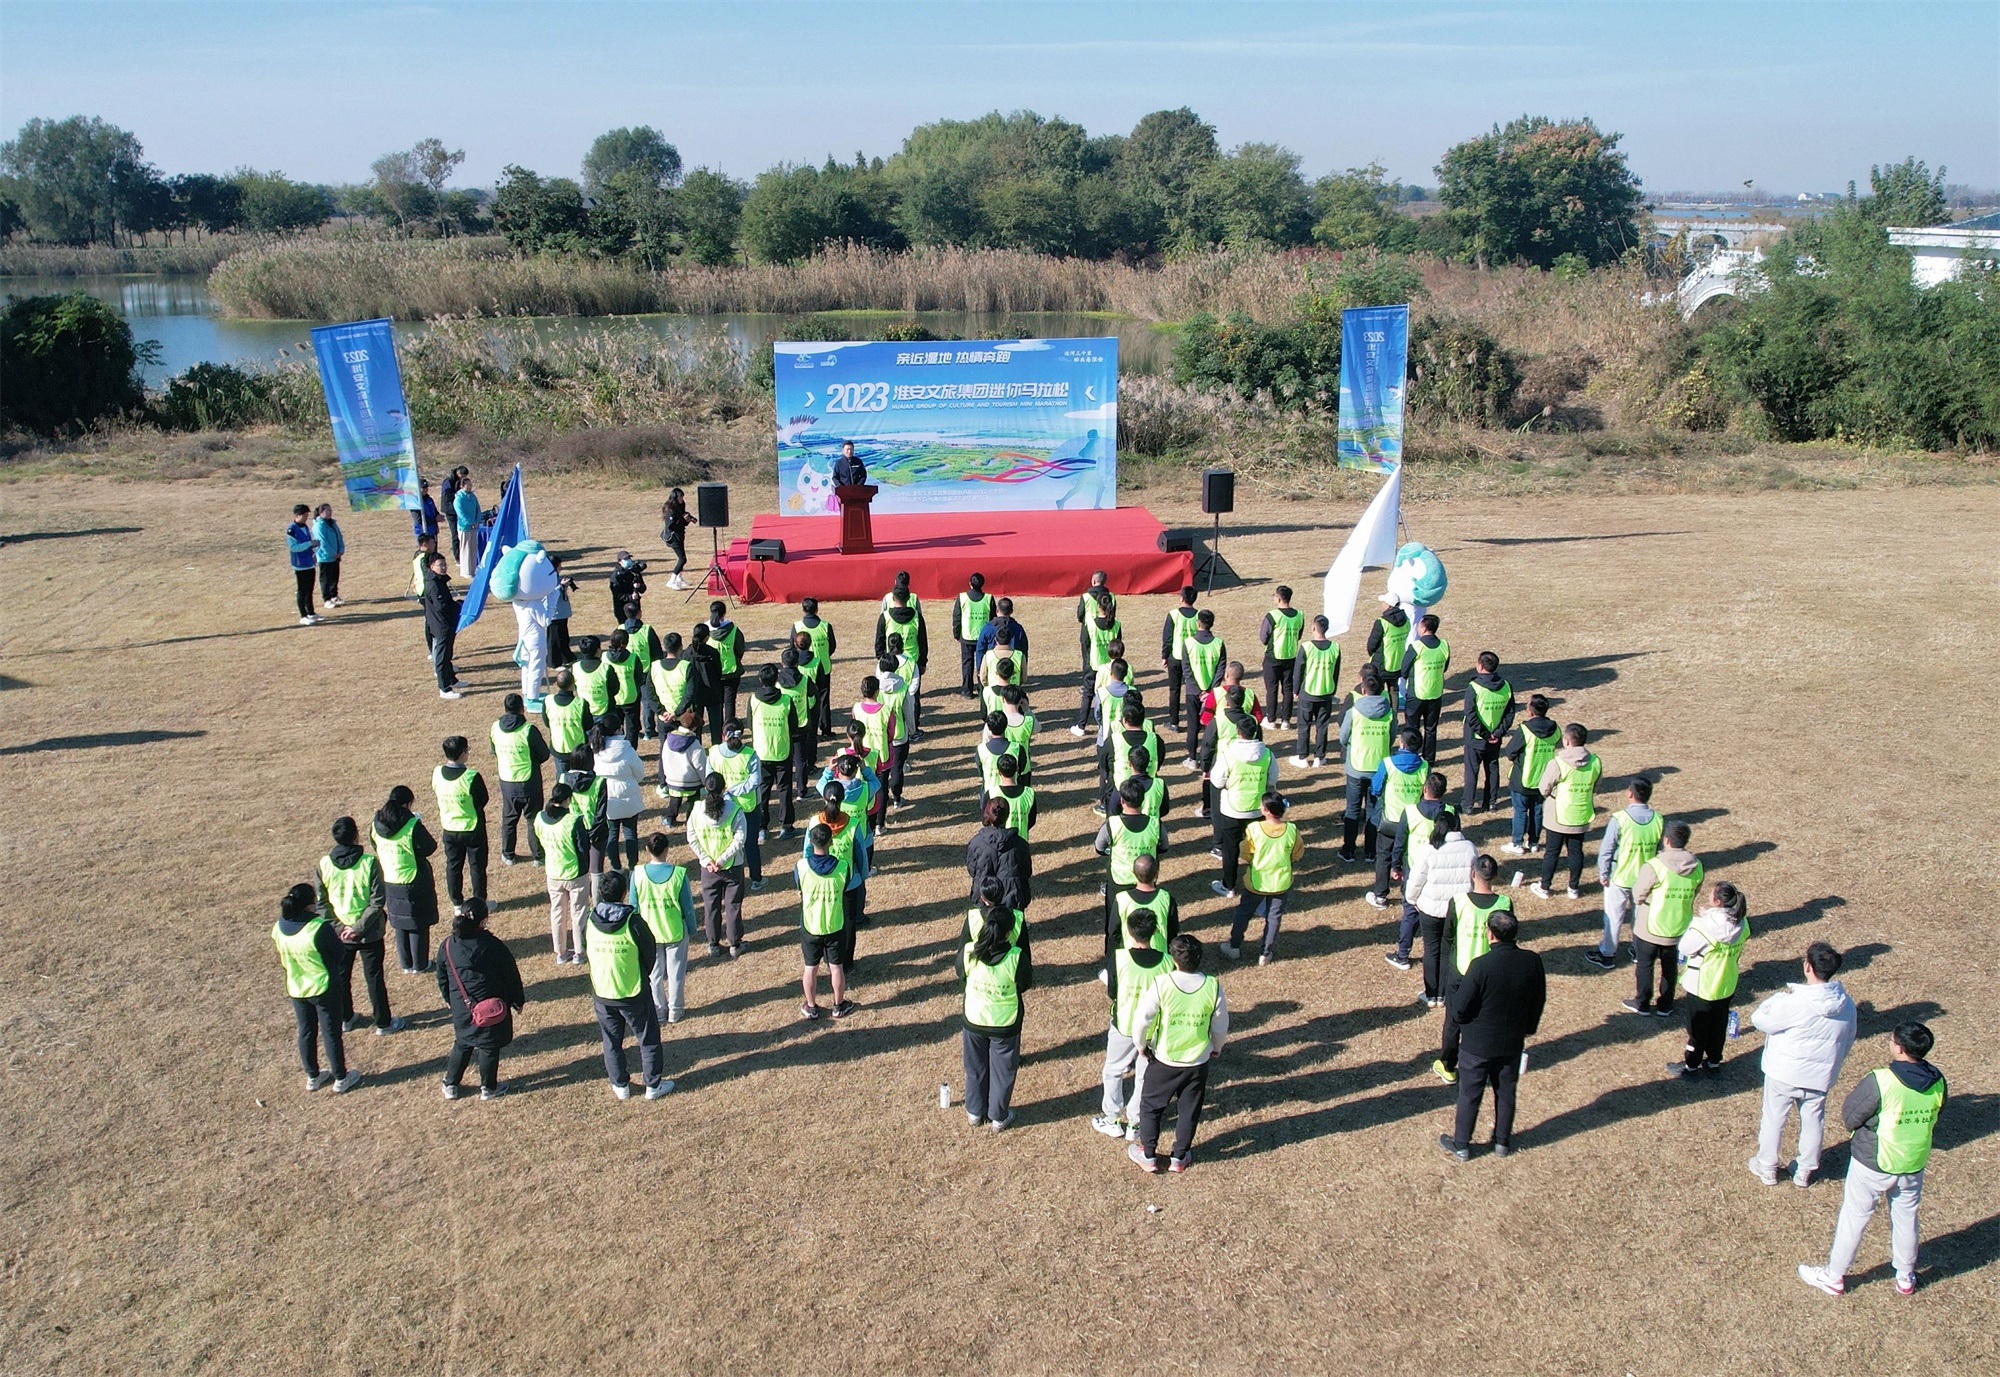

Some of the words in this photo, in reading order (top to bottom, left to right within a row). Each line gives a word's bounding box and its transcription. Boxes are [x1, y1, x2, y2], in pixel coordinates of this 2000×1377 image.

[896, 351, 953, 365] 亲近湿地
[955, 351, 1011, 363] 热情奔跑
[826, 382, 890, 413] 2023
[892, 382, 1069, 401] 淮安文旅集团迷你马拉松
